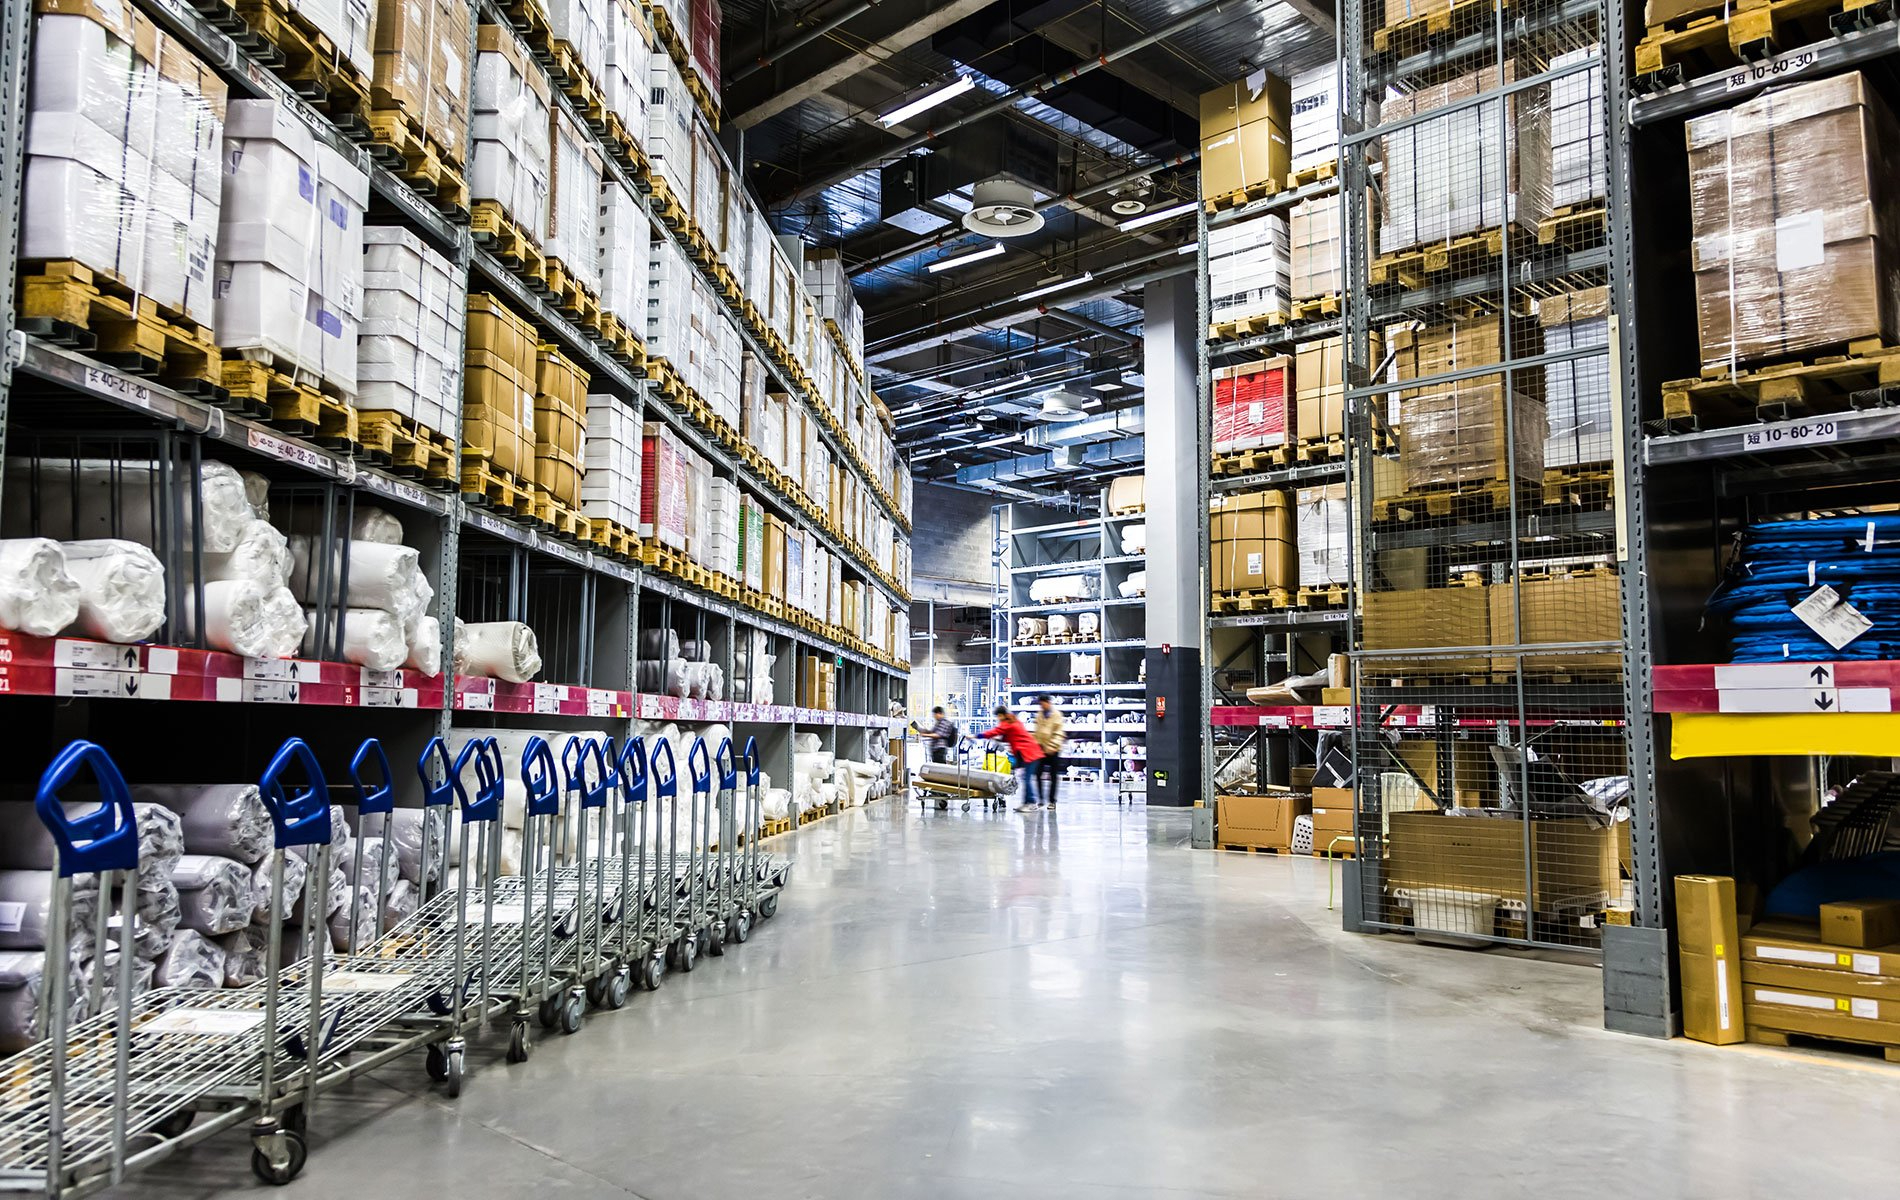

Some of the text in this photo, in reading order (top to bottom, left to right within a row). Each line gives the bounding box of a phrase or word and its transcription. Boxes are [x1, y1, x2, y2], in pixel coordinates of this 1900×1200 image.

[1730, 52, 1813, 87] 短 10-60-30
[101, 372, 147, 400] 40-21-20
[1747, 422, 1834, 445] 短 10-60-20
[285, 445, 316, 466] 40-22-20
